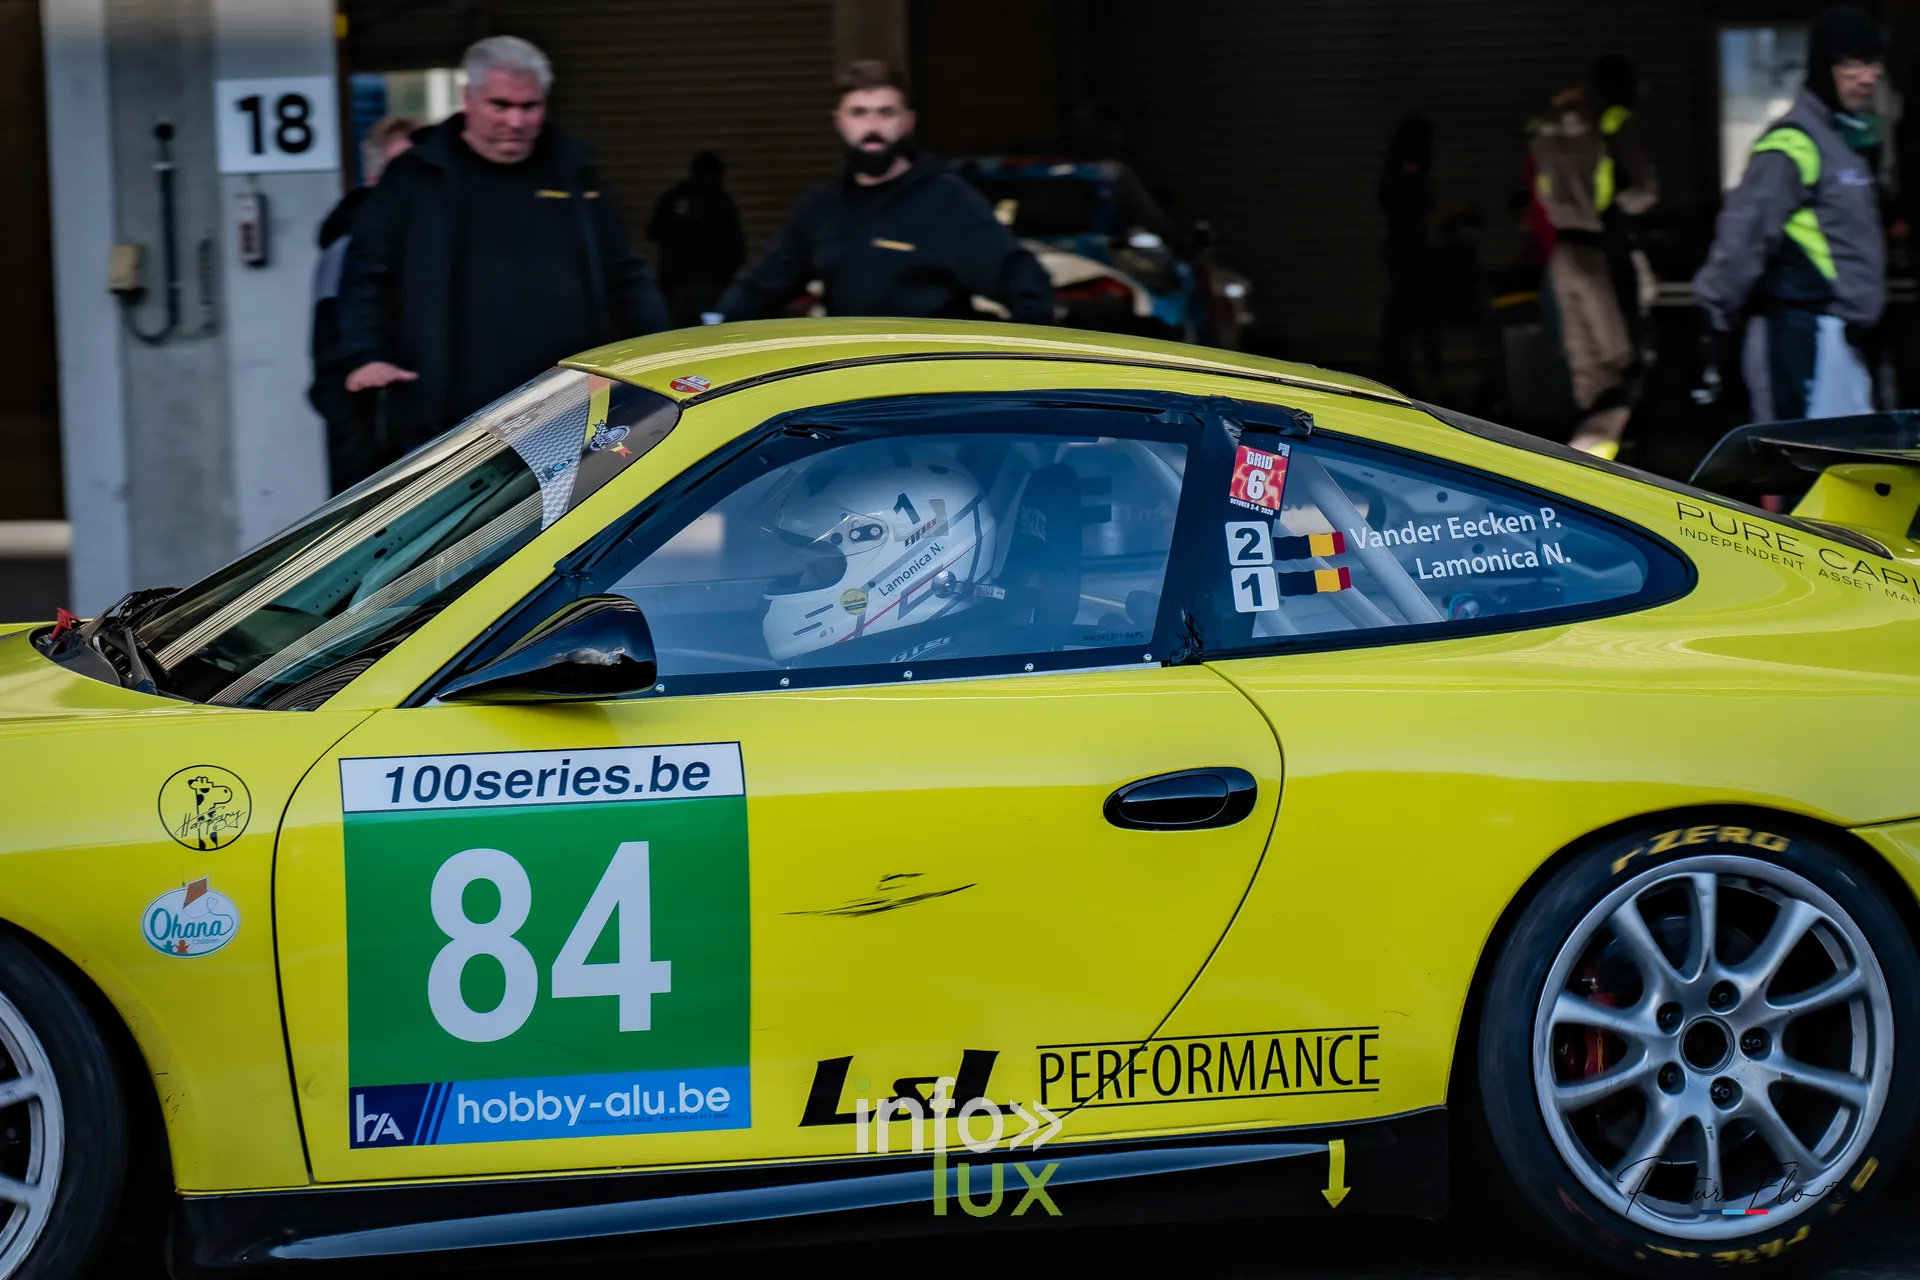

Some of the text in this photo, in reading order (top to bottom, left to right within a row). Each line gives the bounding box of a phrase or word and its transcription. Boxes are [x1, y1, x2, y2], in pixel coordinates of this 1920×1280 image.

[235, 94, 315, 155] 18
[1246, 452, 1274, 470] GRID
[1247, 469, 1266, 500] 6
[893, 492, 921, 525] 1
[1350, 507, 1562, 549] Vander Eecken P.
[1676, 501, 1804, 558] PURE
[1234, 527, 1264, 561] 2
[1416, 542, 1572, 580] Lamonica N.
[1679, 526, 1804, 571] INDEPENDENT
[1819, 568, 1873, 592] ASSET
[878, 542, 945, 597] Lamonica N.
[1241, 573, 1263, 607] 1
[384, 755, 711, 804] 100series.be
[1646, 824, 1791, 857] ZERO
[150, 907, 224, 941] Ohana
[428, 841, 672, 1042] 84
[1039, 1032, 1381, 1106] PERFORMANCE
[457, 1081, 731, 1127] hobby-alu.be
